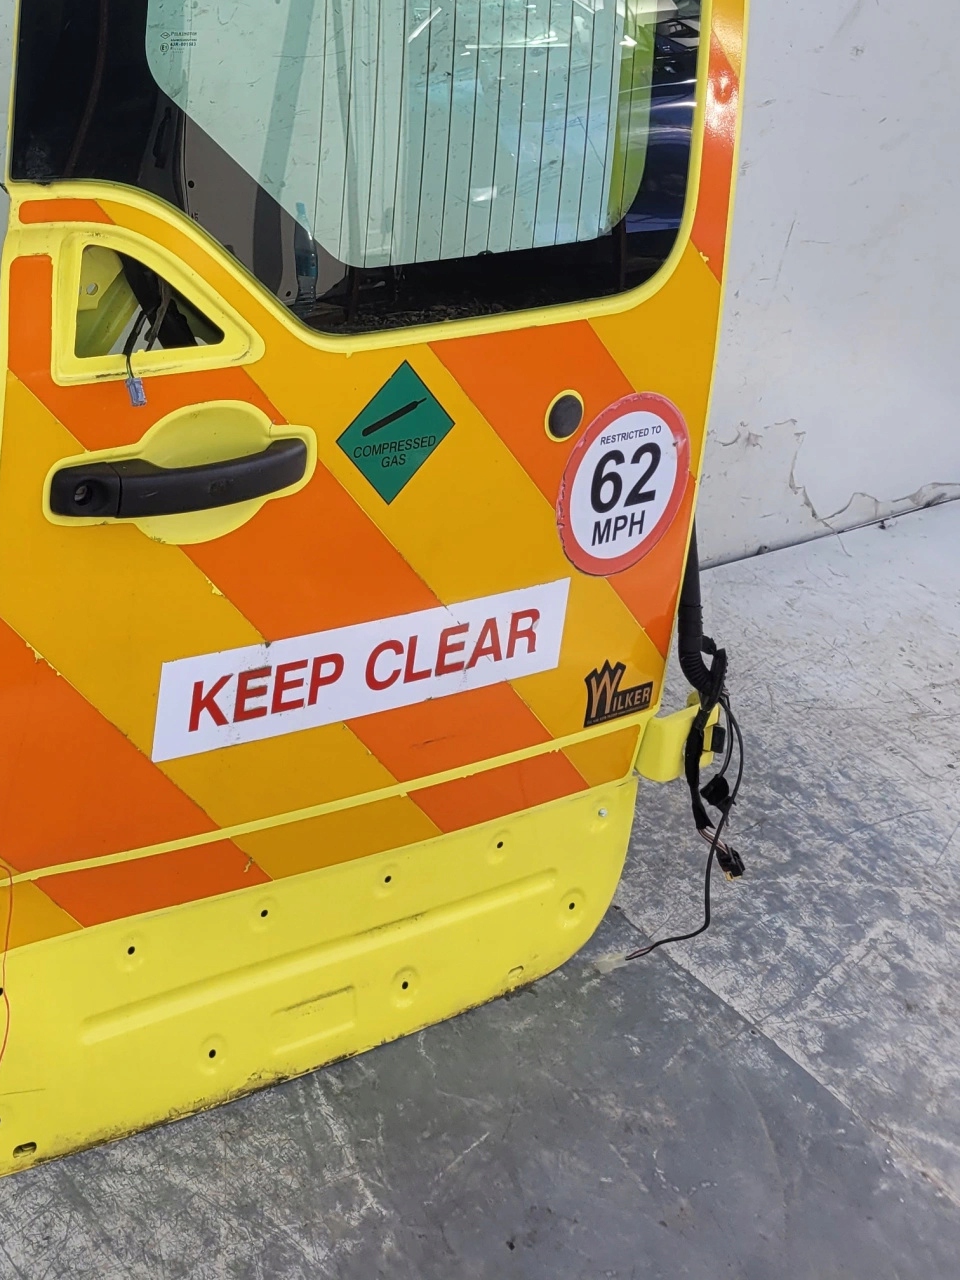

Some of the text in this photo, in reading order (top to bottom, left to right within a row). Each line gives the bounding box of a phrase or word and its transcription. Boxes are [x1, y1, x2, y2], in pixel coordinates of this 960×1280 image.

[353, 435, 436, 459] COMPRESSED
[600, 425, 662, 446] RESTRICTED TO
[381, 453, 407, 468] GAS
[591, 442, 662, 513] 62
[591, 510, 646, 546] MPH
[188, 608, 541, 733] KEEP CLEAR
[590, 668, 651, 719] WILKER
